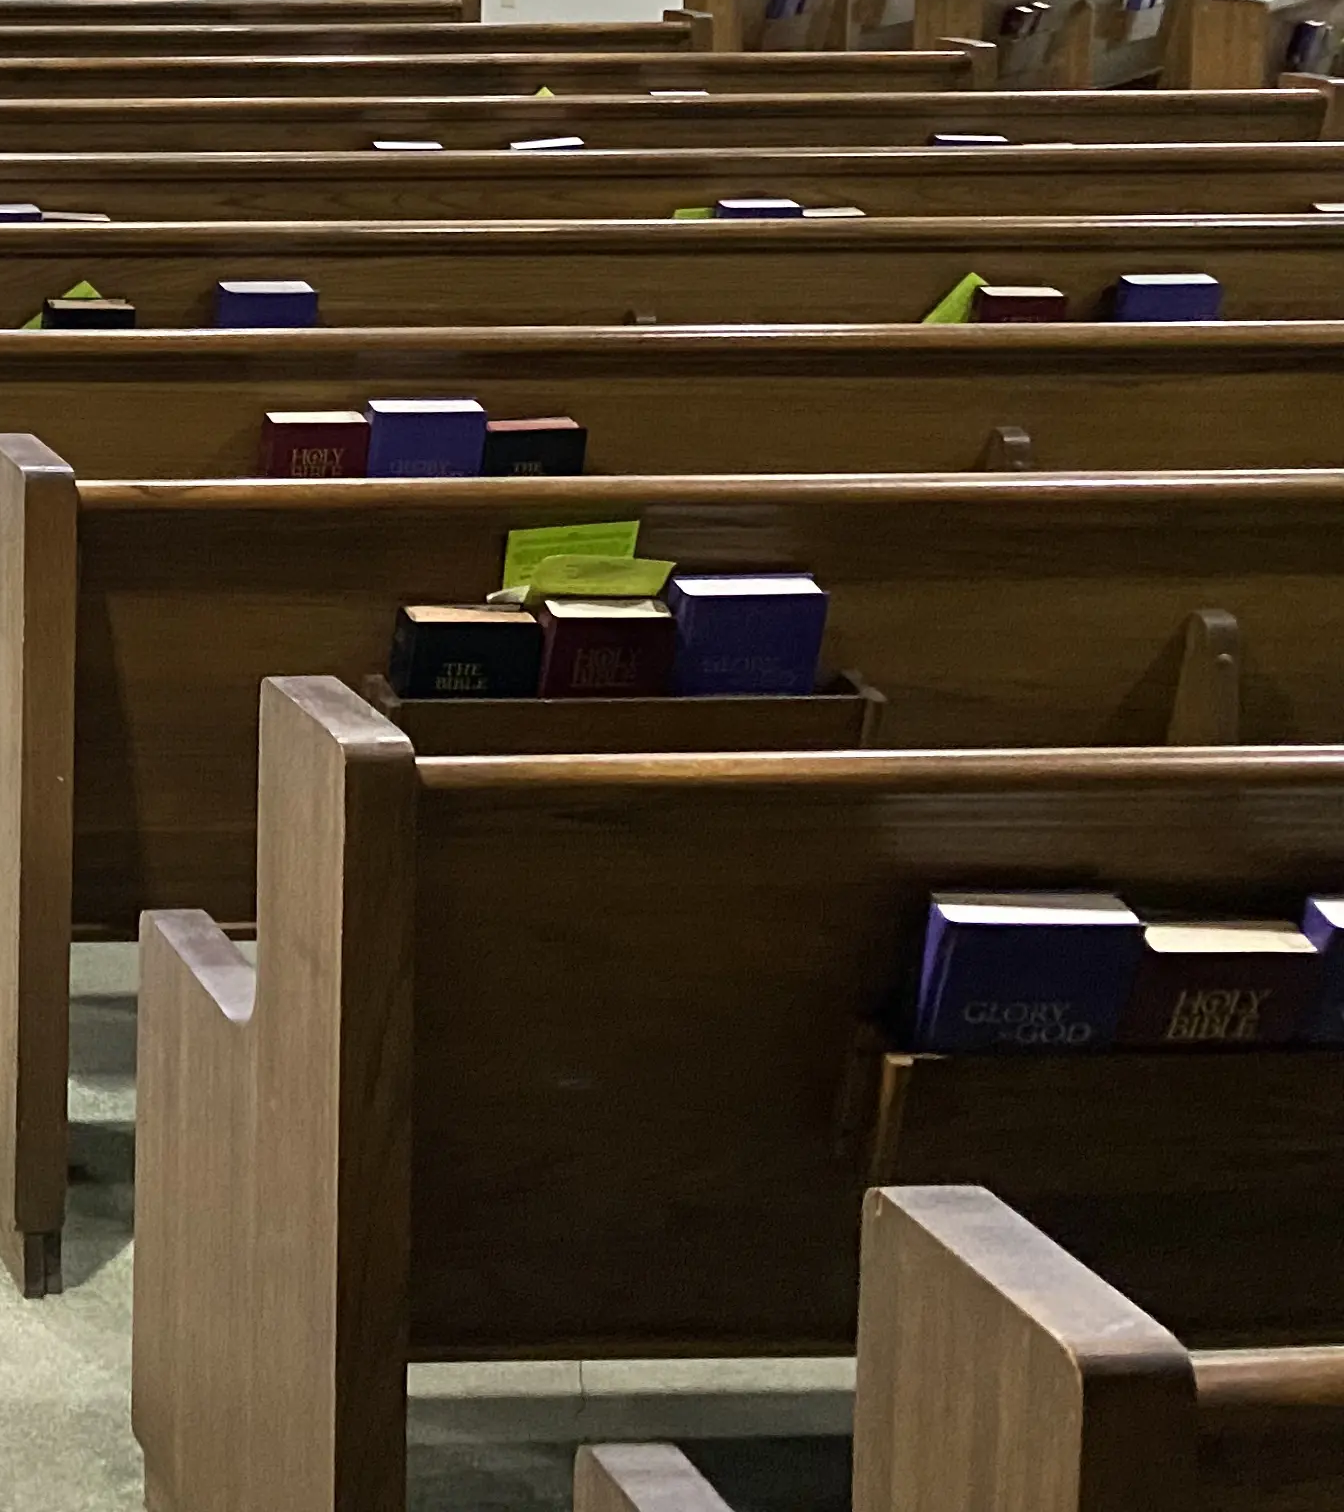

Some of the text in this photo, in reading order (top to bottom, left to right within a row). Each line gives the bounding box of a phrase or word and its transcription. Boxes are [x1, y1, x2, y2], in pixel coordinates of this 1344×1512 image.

[292, 448, 345, 465] HOLY
[442, 662, 484, 676] THE
[575, 648, 641, 669] HOLY
[963, 1000, 1070, 1024] GLORY
[1173, 989, 1273, 1015] HOLY
[1016, 1023, 1092, 1046] GOD
[1166, 1013, 1260, 1040] BIBLE
